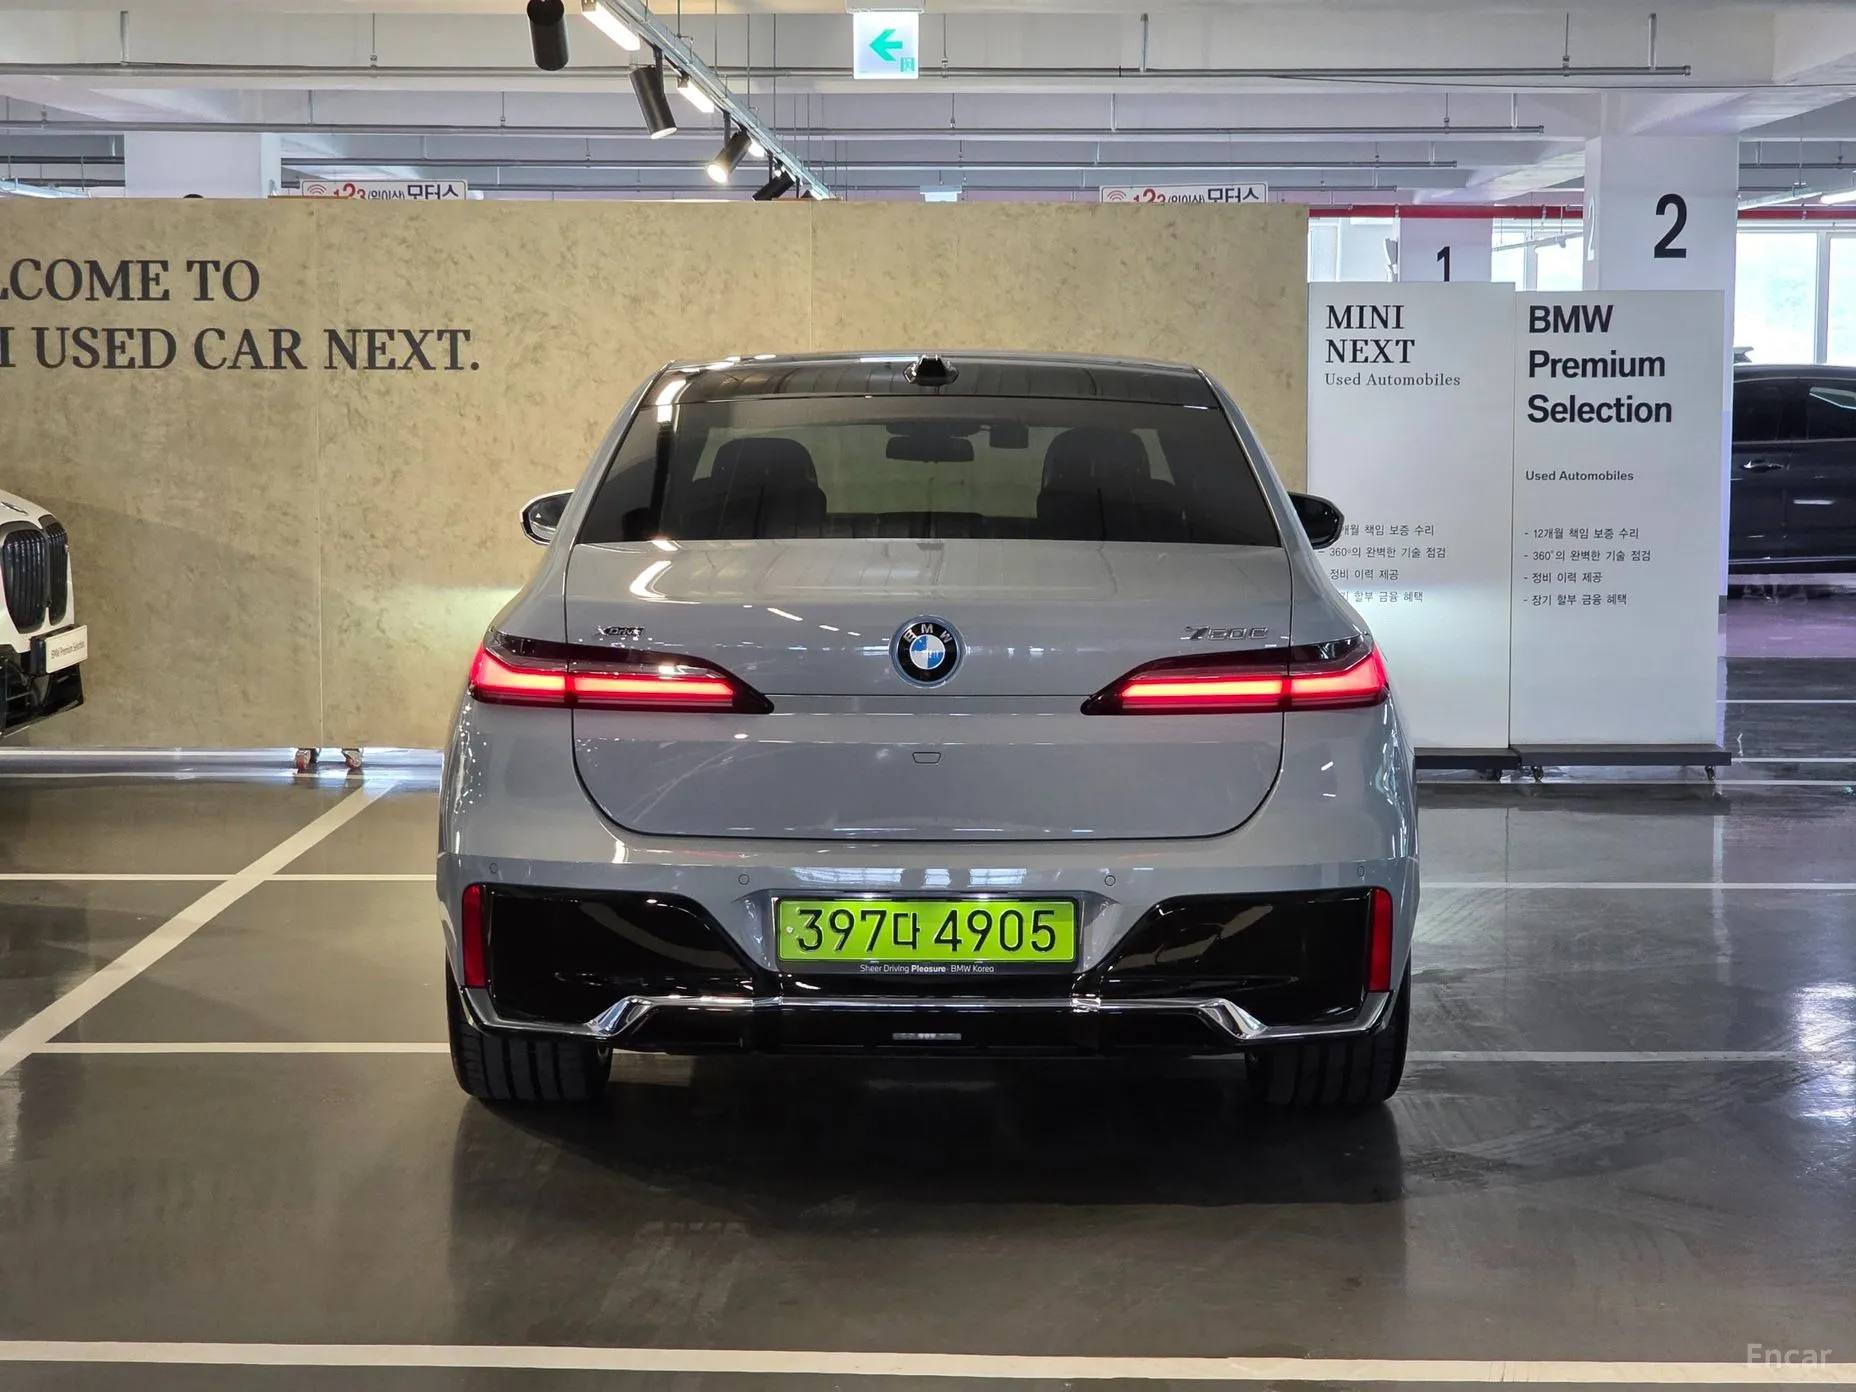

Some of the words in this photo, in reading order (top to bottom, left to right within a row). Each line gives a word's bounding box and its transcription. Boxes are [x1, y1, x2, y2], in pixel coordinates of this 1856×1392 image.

[1654, 193, 1688, 259] 2
[1436, 246, 1451, 282] 1
[187, 259, 260, 302] TO
[1326, 304, 1405, 330] MINI
[1528, 304, 1614, 334] BMW
[31, 326, 177, 369] USED
[194, 327, 308, 370] CAR
[323, 328, 480, 371] NEXT.
[1325, 339, 1416, 364] NEXT
[1528, 349, 1666, 379] Premium
[1325, 372, 1361, 386] Used
[1366, 372, 1461, 386] Automobiles
[1527, 394, 1672, 424] Selection
[1525, 470, 1556, 481] Used
[1558, 470, 1634, 481] Automobiles
[1364, 525, 1384, 536] 책임
[1389, 525, 1409, 536] 보증
[1414, 525, 1434, 536] 수리
[1533, 528, 1564, 540] 12개월
[1569, 528, 1589, 540] 책임
[1594, 528, 1614, 540] 보증
[1618, 528, 1639, 540] 수리
[1366, 547, 1396, 558] 완벽한
[1401, 547, 1421, 558] 기술
[1426, 547, 1446, 558] 점검
[1570, 550, 1600, 562] 완벽한
[1606, 550, 1626, 562] 기술
[1631, 550, 1651, 562] 점검
[1330, 569, 1349, 580] 정비
[1354, 569, 1374, 580] 이력
[1379, 569, 1399, 580] 제공
[1532, 572, 1552, 583] 정비
[1557, 572, 1577, 583] 이력
[1582, 572, 1602, 583] 제공
[1403, 591, 1423, 602] 혜택
[1532, 594, 1552, 606] 장기
[1557, 594, 1577, 606] 할부
[1582, 594, 1601, 606] 금융
[1607, 594, 1627, 606] 혜택
[903, 623, 953, 644] BMW
[798, 909, 921, 952] 397다
[933, 909, 1056, 952] 4905
[860, 964, 882, 973] Sheer
[883, 964, 909, 974] Driving
[911, 964, 946, 973] Pleasure
[951, 964, 971, 973] BMW
[972, 964, 994, 973] Korea
